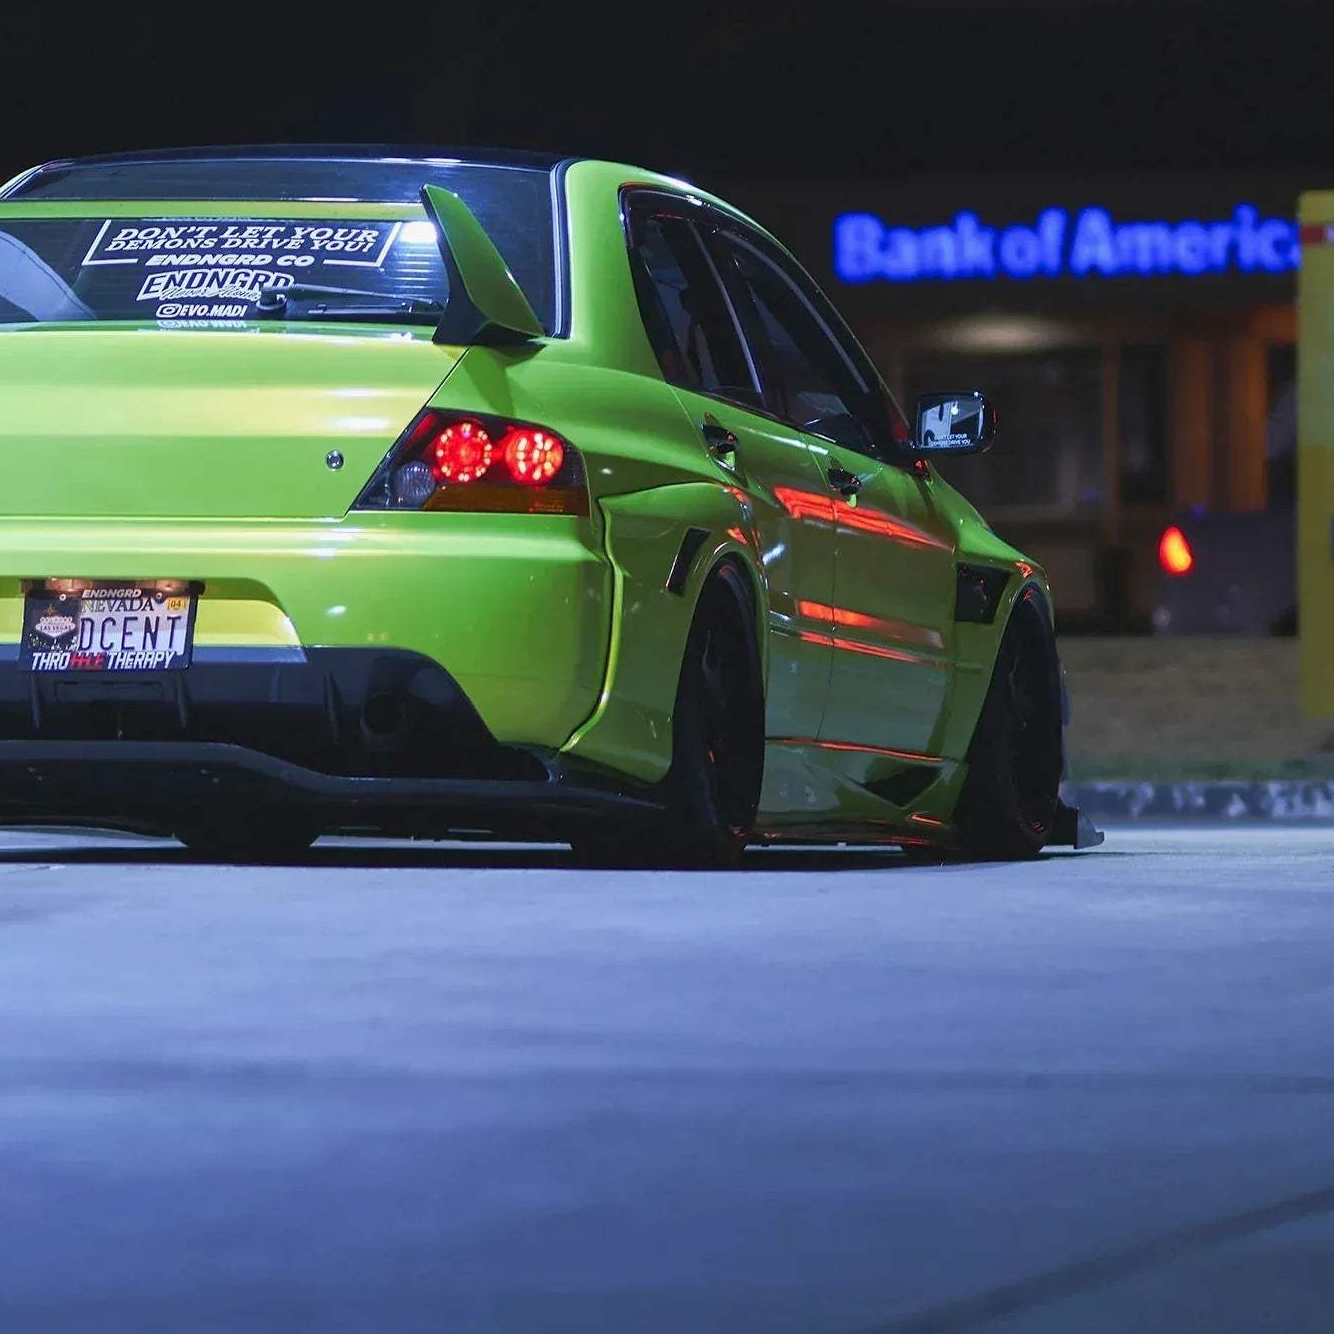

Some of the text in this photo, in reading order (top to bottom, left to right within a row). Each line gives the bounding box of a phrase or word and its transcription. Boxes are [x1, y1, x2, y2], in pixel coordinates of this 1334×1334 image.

[112, 226, 381, 243] DON'T LET YOUR
[834, 202, 1301, 282] Bank of Americ
[104, 238, 375, 253] DEMONS DRIVE YOU!
[145, 254, 316, 267] ENDNGRD CO
[82, 589, 142, 599] ENDNGRD
[81, 597, 155, 613] NEVADA
[78, 616, 182, 651] DCENT
[107, 651, 176, 670] THERAPY
